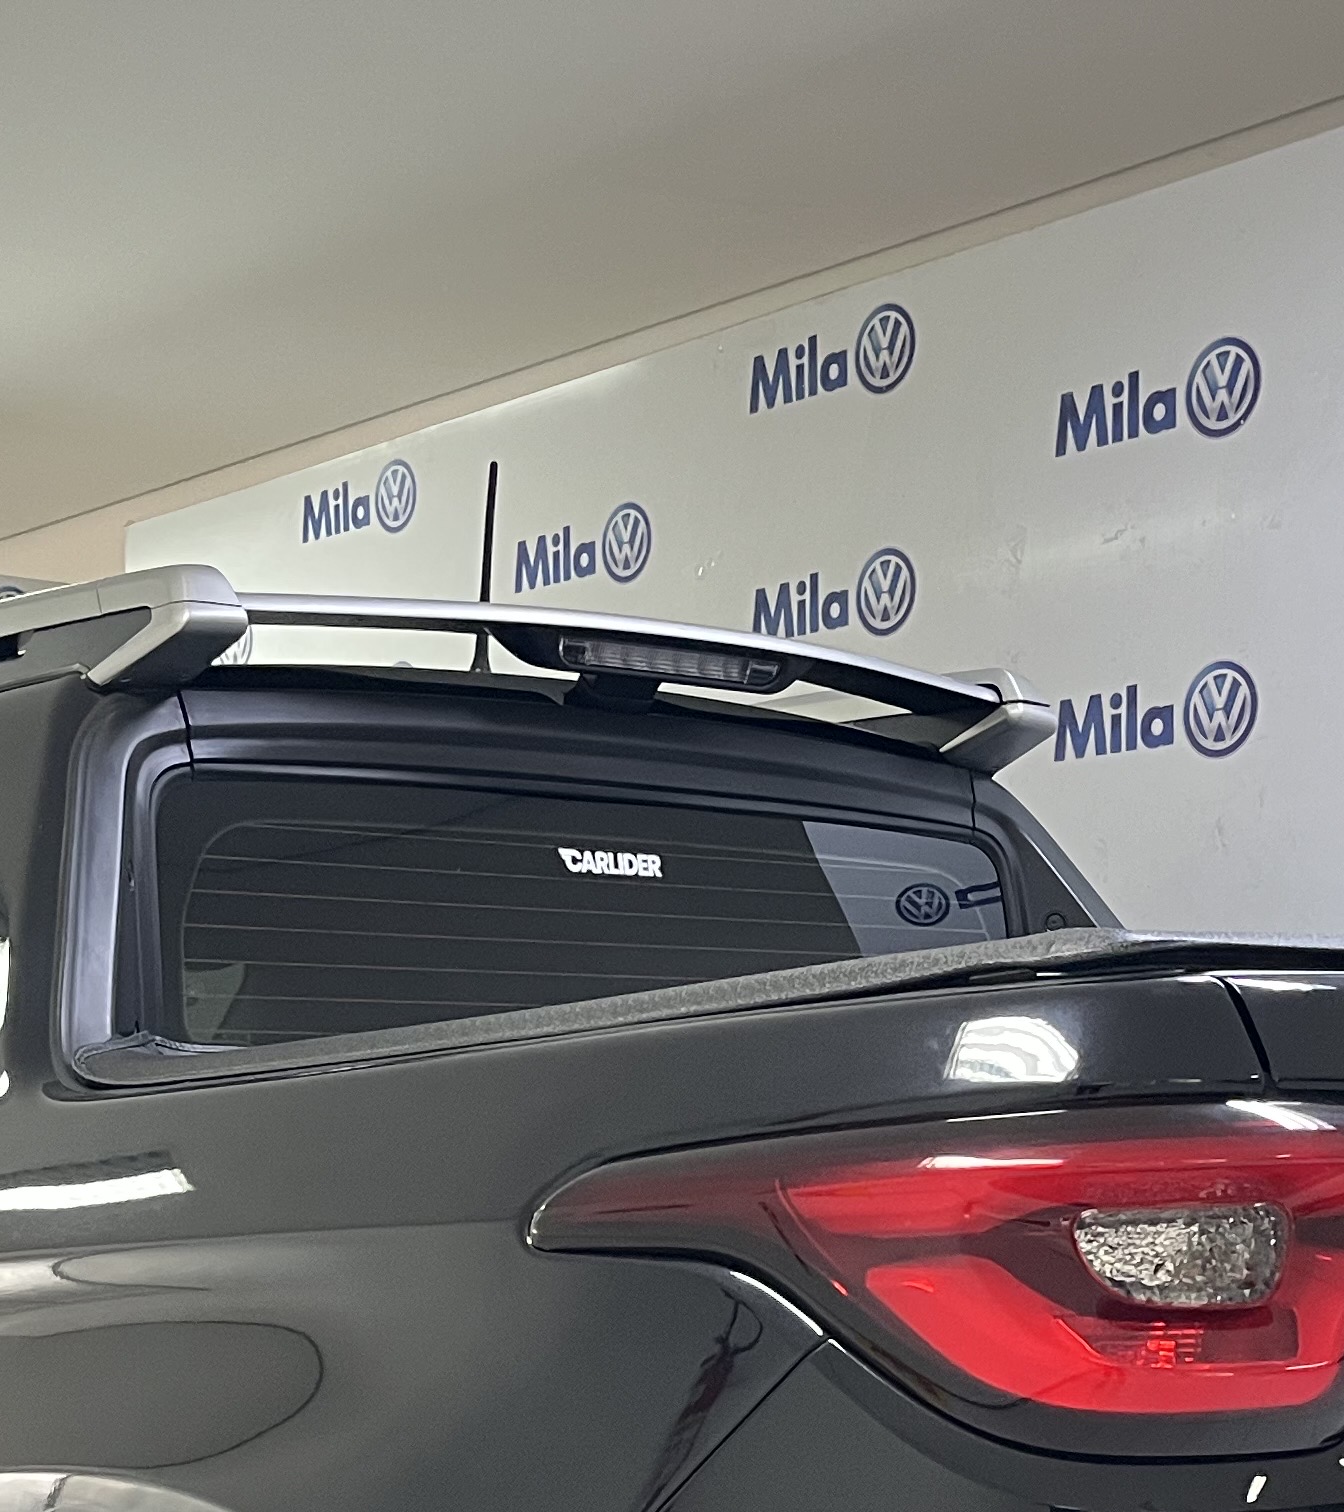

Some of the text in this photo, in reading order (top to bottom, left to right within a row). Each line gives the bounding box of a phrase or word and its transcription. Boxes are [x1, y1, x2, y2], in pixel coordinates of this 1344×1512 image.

[749, 333, 848, 415] Mila
[1054, 369, 1177, 458] Mila
[302, 480, 371, 544] Mila
[514, 525, 597, 594] Mila
[752, 571, 850, 639] Mila
[1050, 683, 1175, 763] Mila
[557, 846, 663, 878] CARLIDER
